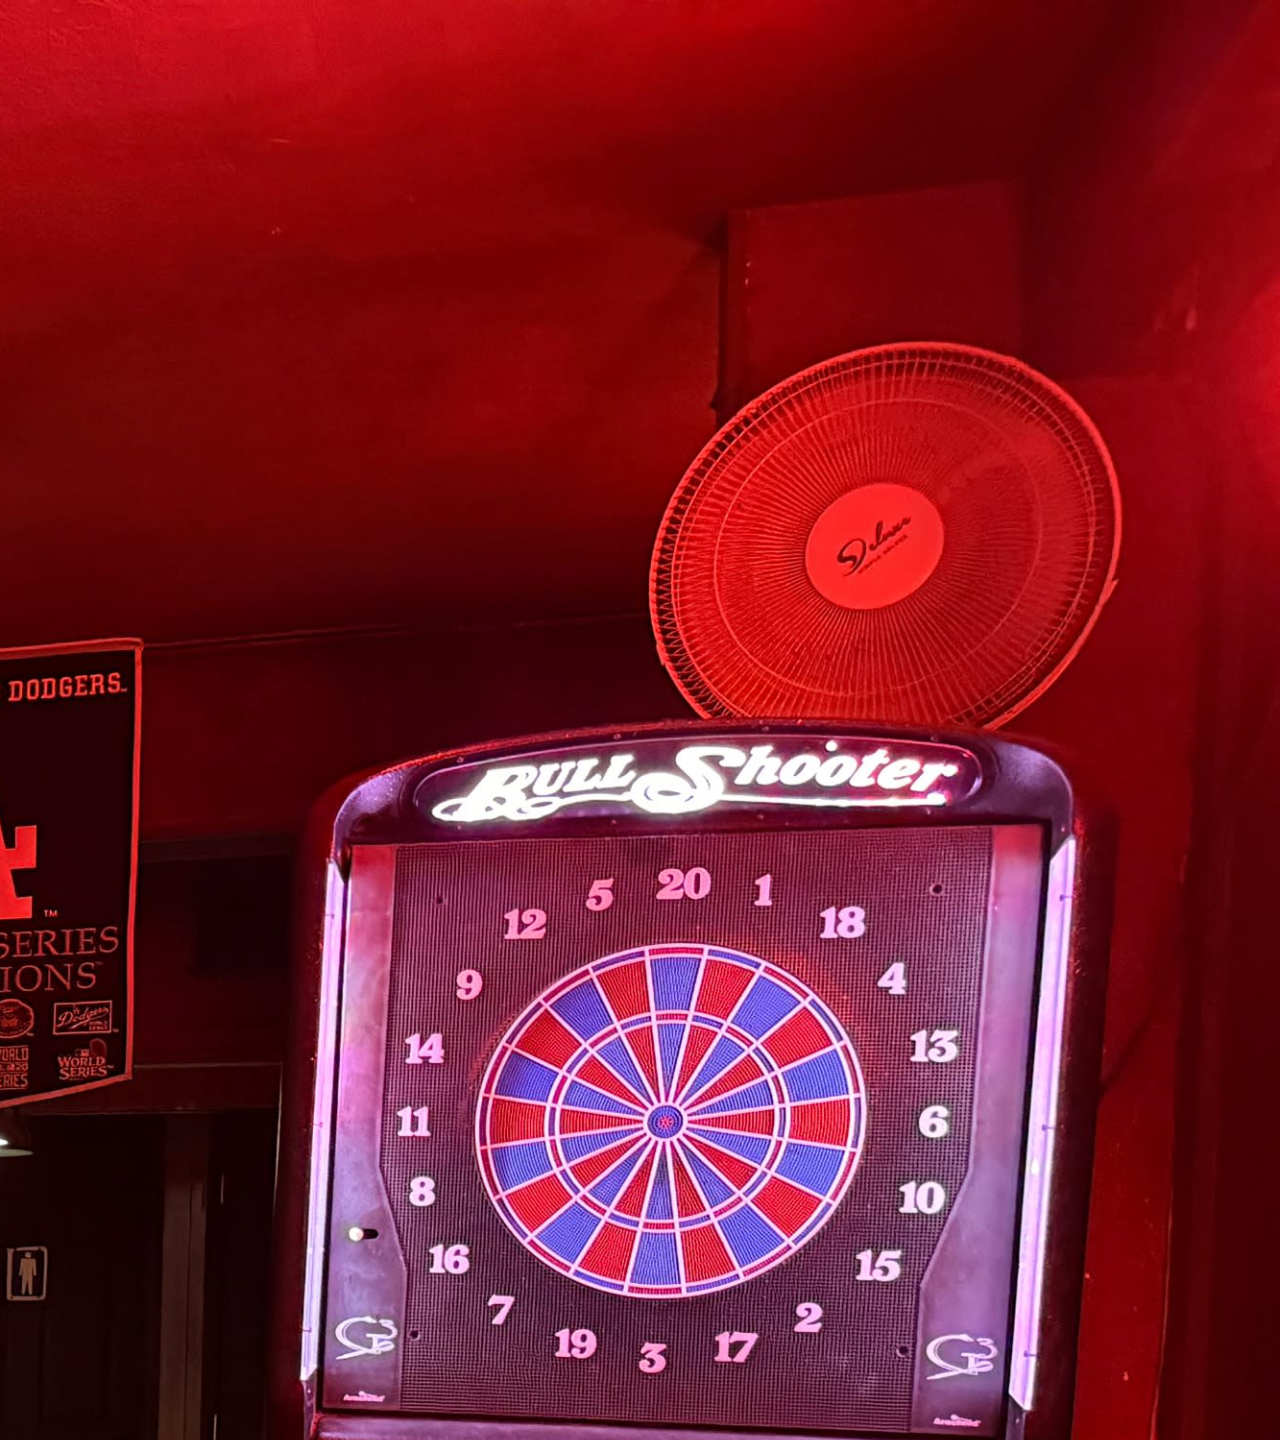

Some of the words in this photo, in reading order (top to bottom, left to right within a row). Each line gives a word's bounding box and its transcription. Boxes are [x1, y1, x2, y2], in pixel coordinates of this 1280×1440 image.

[8, 672, 122, 701] DODGERS
[432, 755, 637, 822] BULL
[632, 740, 959, 813] Shooter
[586, 878, 615, 910] 5
[656, 867, 711, 900] 20
[754, 875, 773, 906] 1
[503, 908, 547, 940] 12
[819, 906, 865, 938] 18
[456, 969, 483, 1000] 9
[878, 962, 907, 995] 4
[58, 1056, 105, 1068] WORLD
[404, 1031, 444, 1064] 14
[909, 1030, 960, 1063] 13
[59, 1067, 107, 1080] SERIES
[396, 1106, 431, 1137] 11
[919, 1105, 948, 1139] 6
[409, 1176, 436, 1207] 8
[898, 1181, 945, 1215] 10
[428, 1244, 469, 1274] 16
[856, 1250, 901, 1282] 15
[488, 1296, 515, 1325] 7
[794, 1302, 822, 1333] 2
[554, 1329, 598, 1360] 19
[639, 1343, 667, 1374] 3
[715, 1332, 759, 1364] 17
